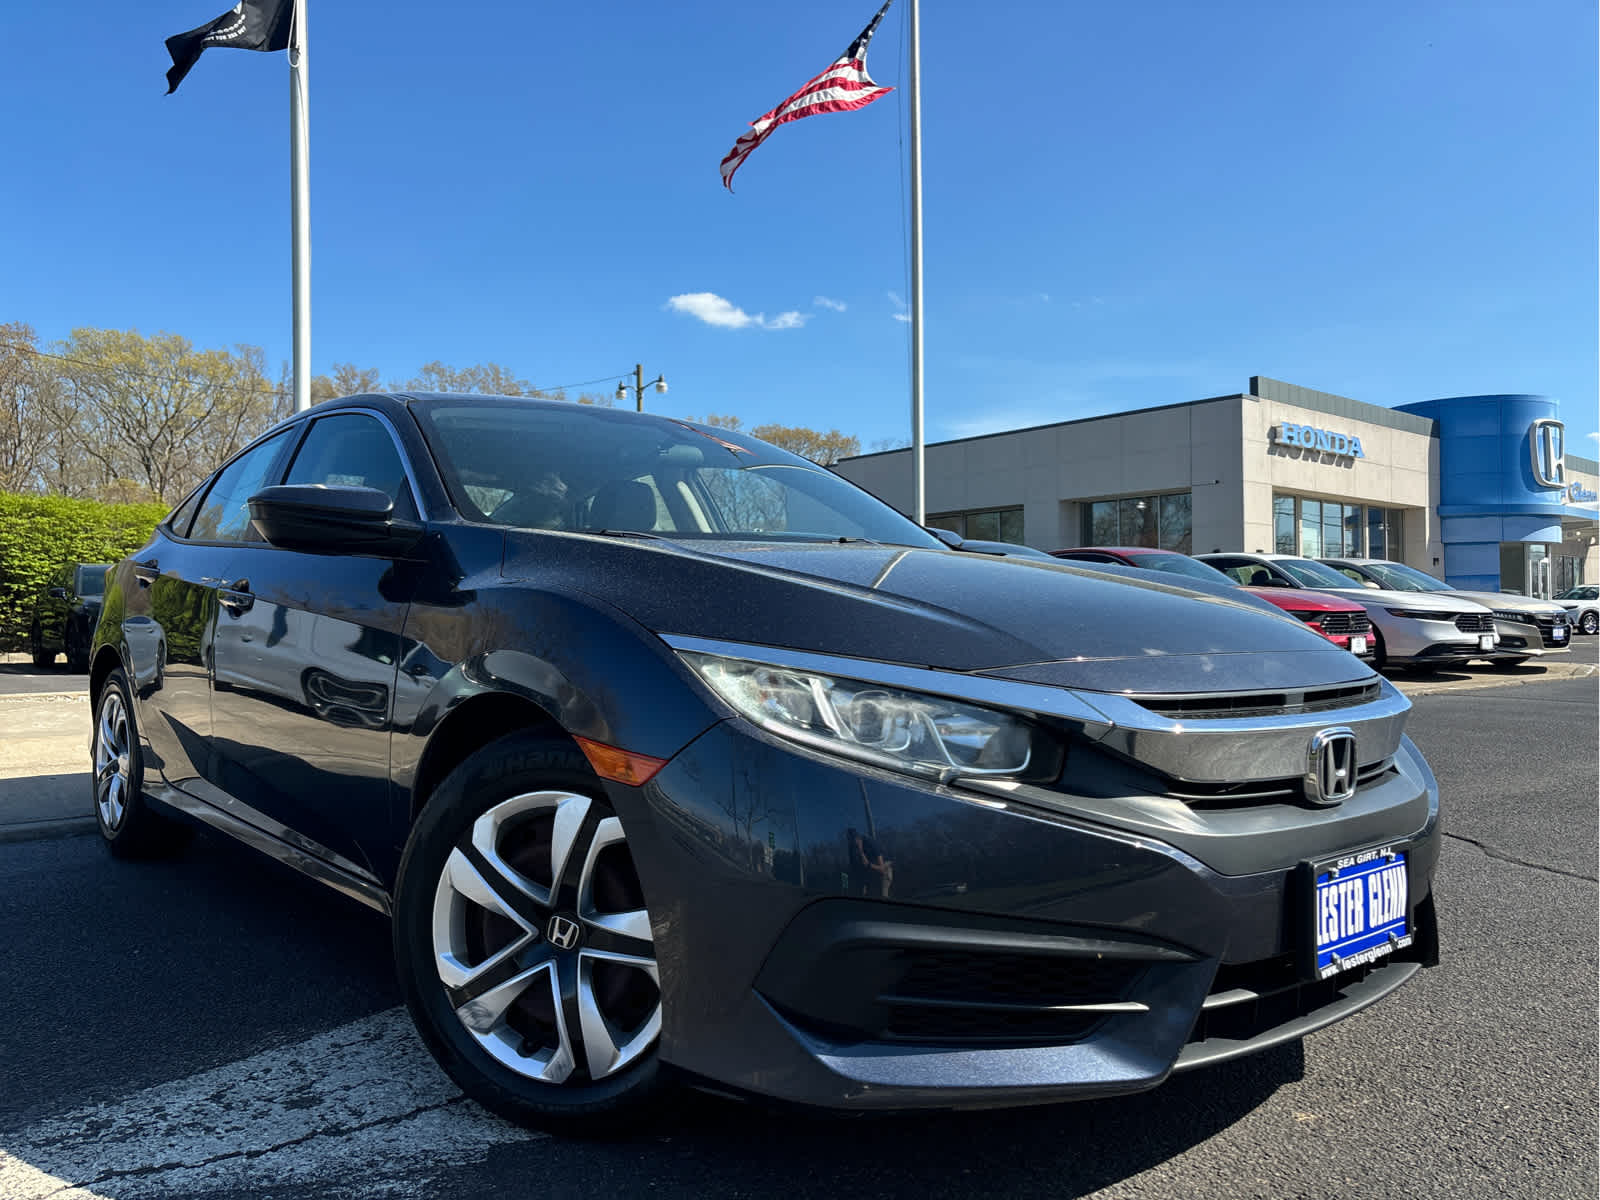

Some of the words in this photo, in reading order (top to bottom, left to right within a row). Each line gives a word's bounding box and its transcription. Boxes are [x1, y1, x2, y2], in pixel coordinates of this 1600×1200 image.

[1281, 421, 1365, 458] HONDA
[1337, 857, 1355, 869] SEA
[1317, 878, 1364, 946] LESTER
[1368, 865, 1407, 928] GLENN
